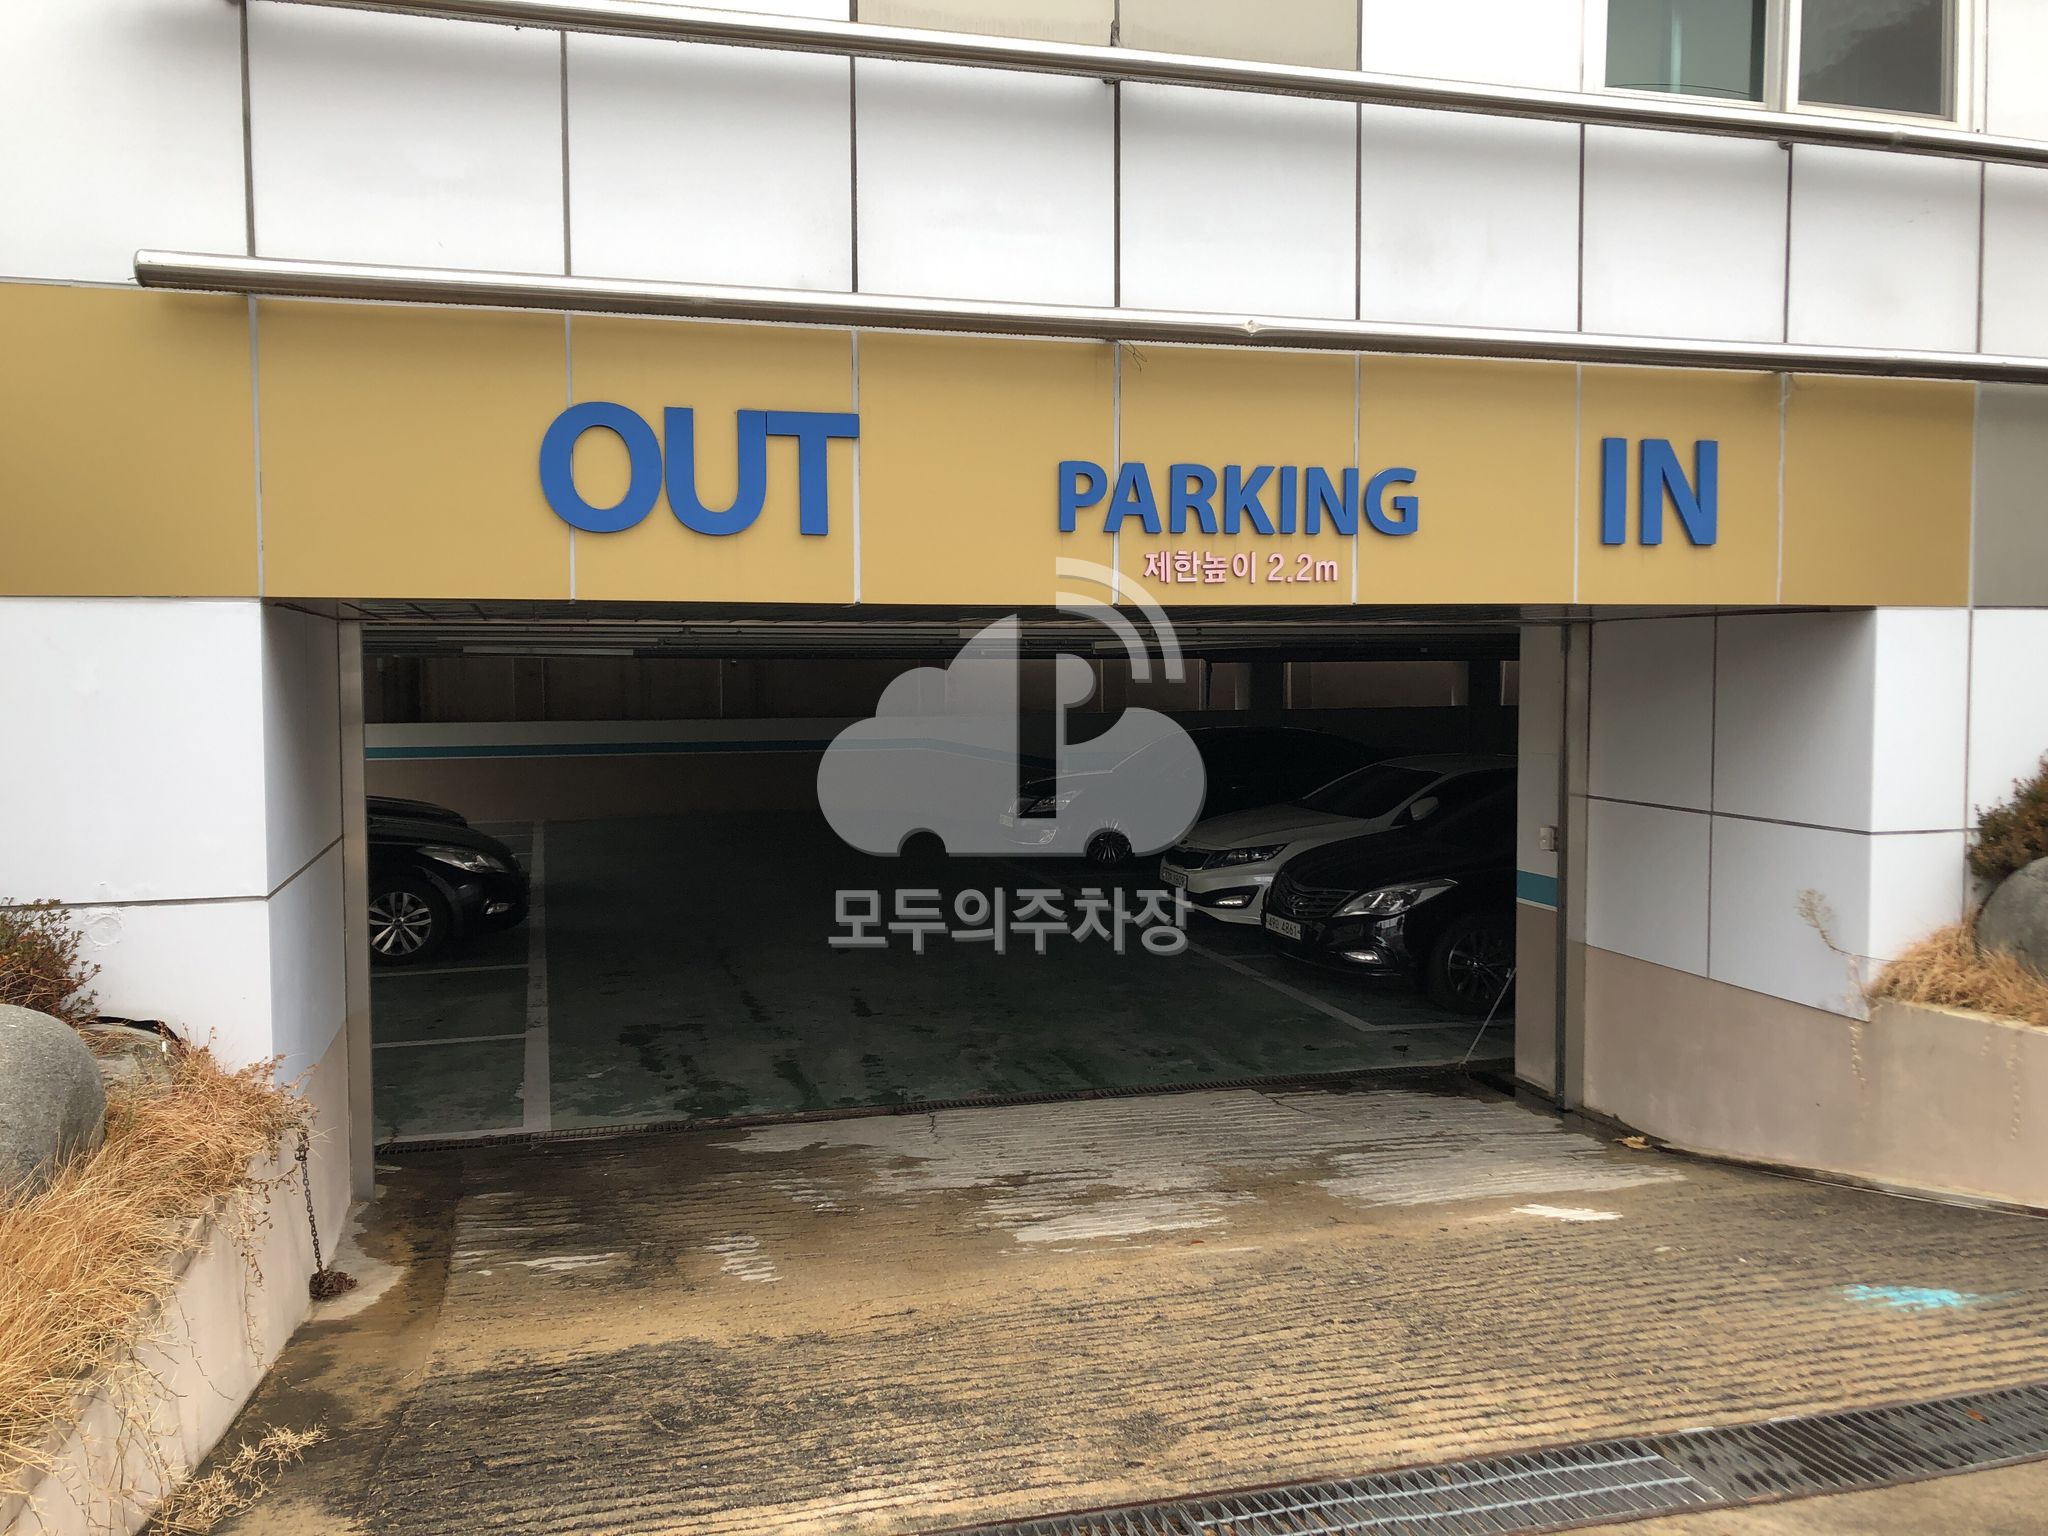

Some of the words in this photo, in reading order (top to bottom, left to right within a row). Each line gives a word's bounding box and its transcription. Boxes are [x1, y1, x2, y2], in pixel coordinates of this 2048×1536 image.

[539, 401, 859, 535] OUT
[1058, 460, 1419, 536] PARKING
[1601, 437, 1719, 546] IN
[1143, 550, 1257, 584] 제한높이
[1266, 552, 1339, 583] 2.2m
